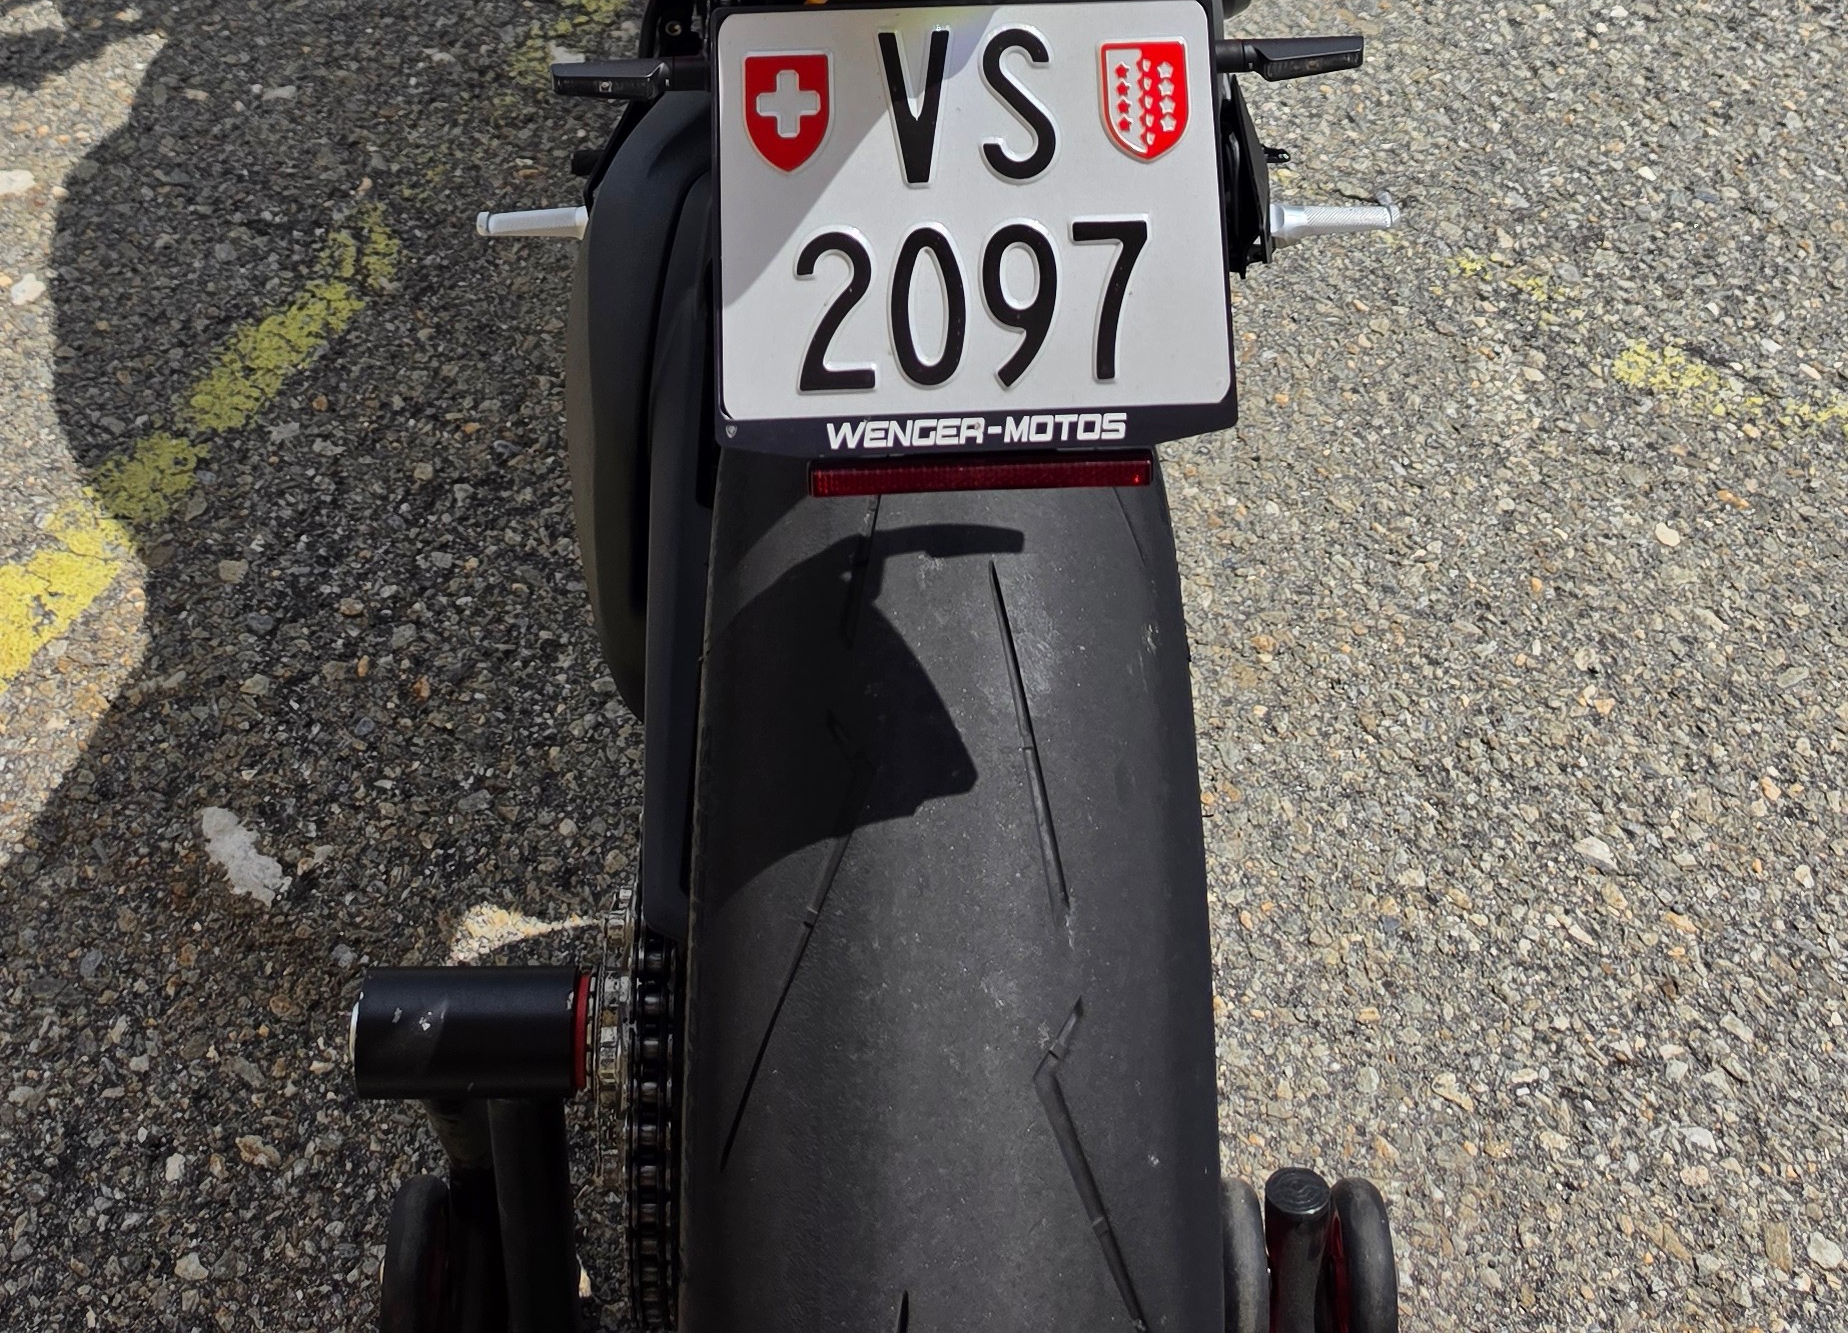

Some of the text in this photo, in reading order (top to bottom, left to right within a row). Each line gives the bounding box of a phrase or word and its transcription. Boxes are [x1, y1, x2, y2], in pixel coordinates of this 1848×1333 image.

[878, 27, 1055, 184] VS
[795, 221, 1149, 392] 2097
[826, 412, 1127, 450] WENGER-MOTOS
